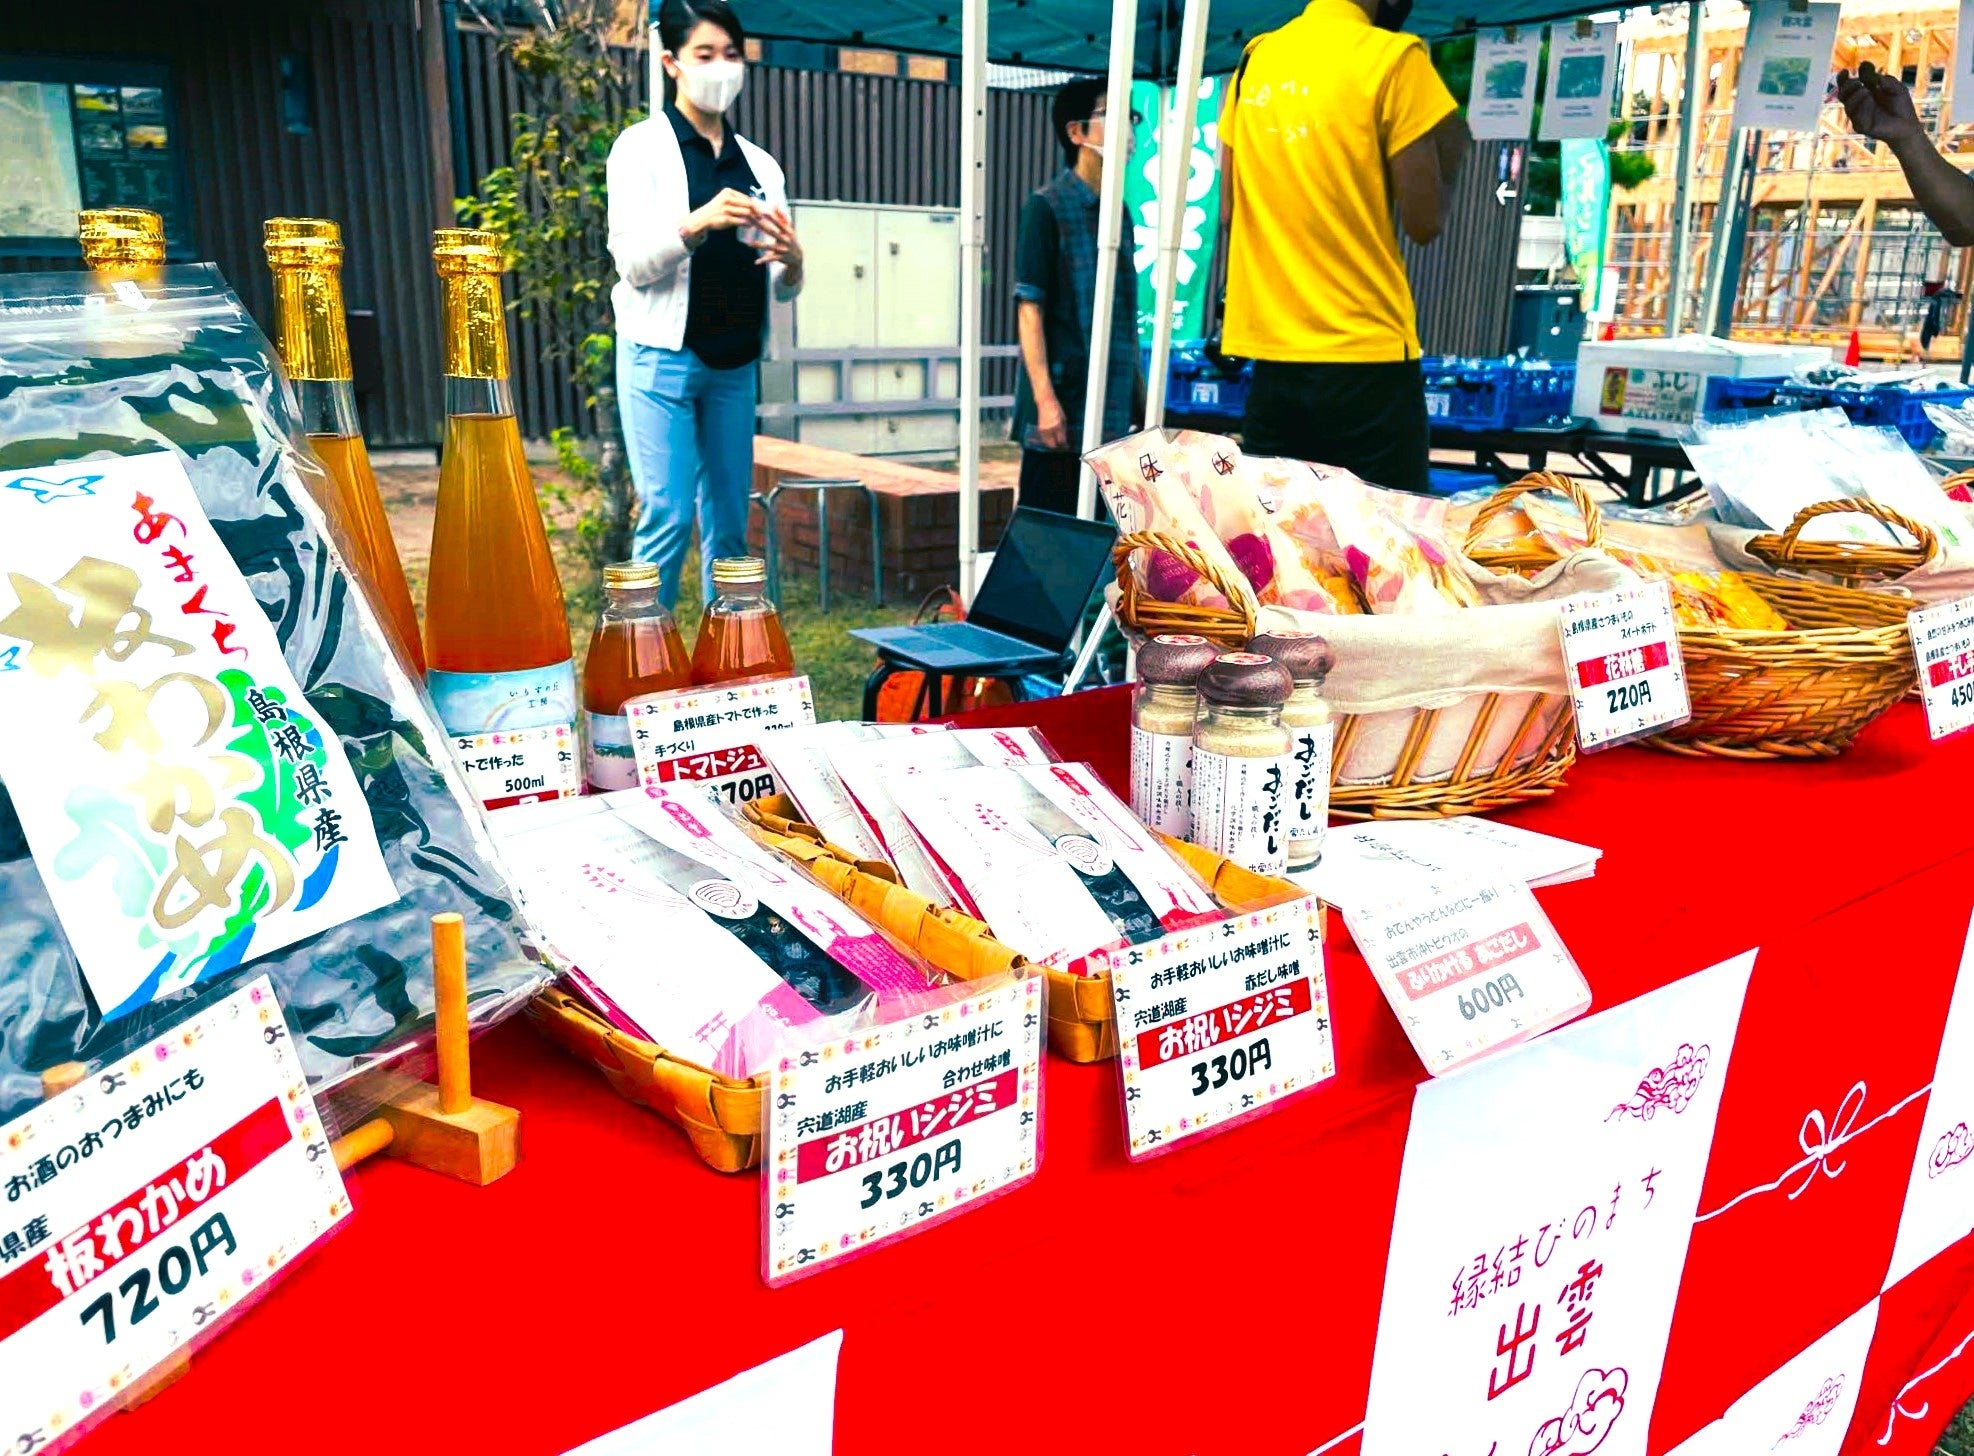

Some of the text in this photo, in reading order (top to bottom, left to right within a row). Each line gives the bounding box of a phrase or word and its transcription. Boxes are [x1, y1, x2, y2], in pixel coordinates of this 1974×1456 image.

[133, 491, 248, 662] あまくち
[1571, 610, 1634, 636] 島根県産さつまいもの
[673, 703, 779, 733] 島根県産トマトで作った
[1606, 679, 1652, 714] 220円
[1951, 681, 1974, 708] 450
[246, 688, 350, 852] 島根県産
[461, 753, 525, 774] トで作った
[654, 740, 696, 758] 手づくり
[505, 775, 545, 793] 500ml
[712, 773, 776, 806] 70円
[1293, 733, 1318, 822] あごだし
[1262, 763, 1284, 855] あごだし
[1151, 932, 1291, 990] お手軽おいしいお味噌汁に
[1385, 928, 1469, 969] 出雲市沖トビウオの
[1477, 930, 1528, 963] あごだし
[1245, 960, 1300, 991] 赤だし味噌
[1457, 972, 1524, 1021] 600円
[1135, 997, 1187, 1028] 宍道湖産
[1158, 988, 1294, 1060] お祝いシジミ
[825, 1020, 1004, 1094] お手軽おいしいお味噌汁に
[942, 1049, 1012, 1090] 合わせ味噌
[1191, 1038, 1272, 1096] 330円
[4, 1068, 206, 1202] お酒のおつまみにも
[797, 1100, 868, 1137] 宍道湖産
[825, 1081, 998, 1173] お祝いシジミ
[860, 1138, 962, 1210] 330円
[45, 1147, 227, 1298] 板わかめ
[1447, 1167, 1663, 1318] 縁結びのまち
[80, 1211, 237, 1344] 720円
[1487, 1258, 1603, 1401] 出雲
